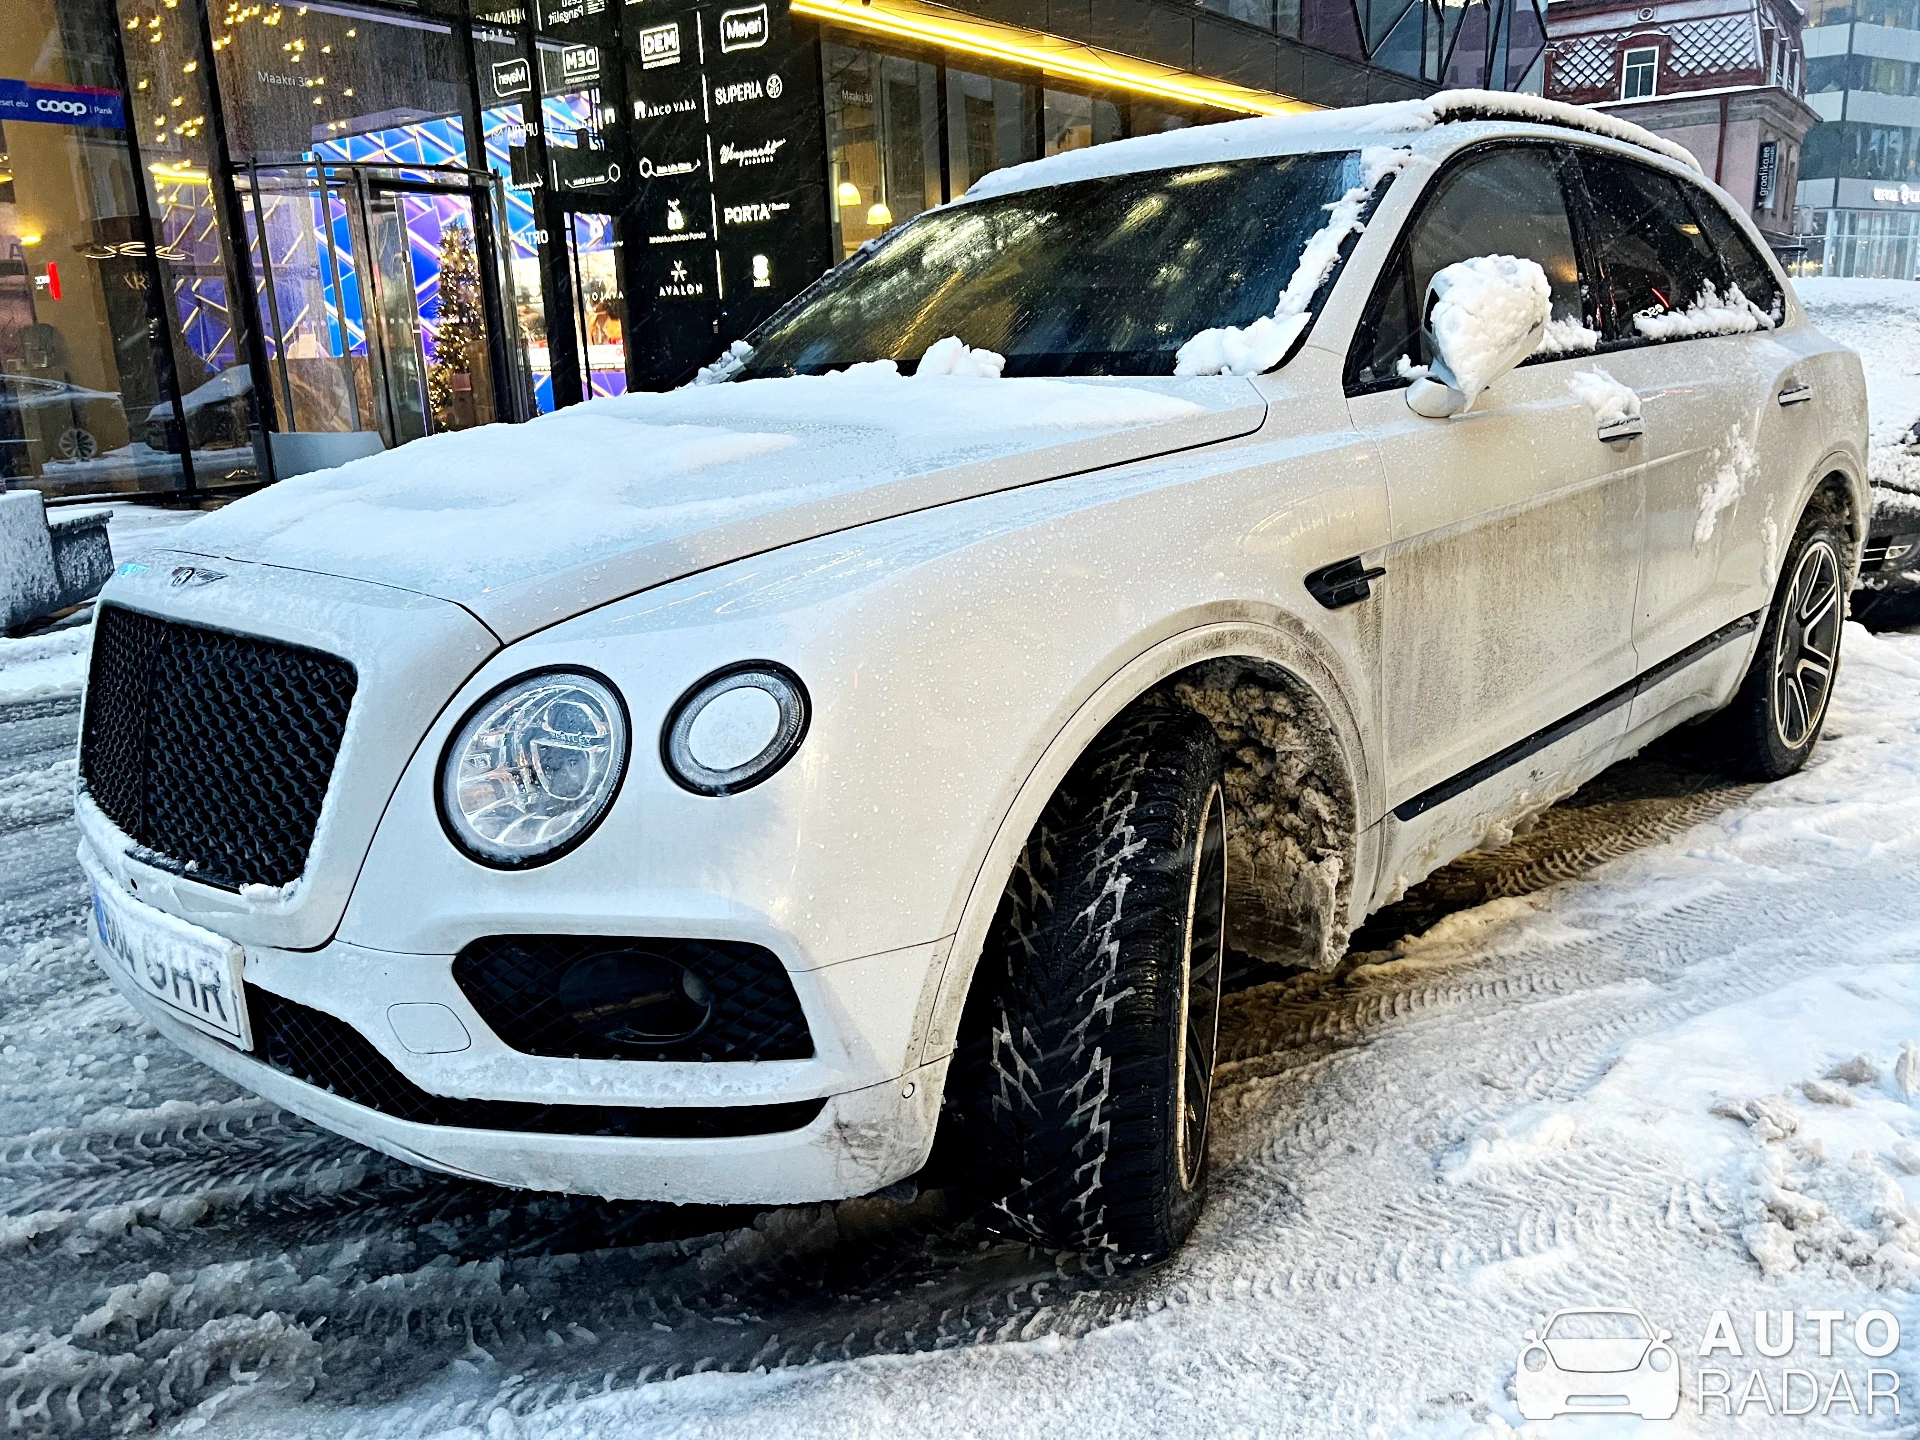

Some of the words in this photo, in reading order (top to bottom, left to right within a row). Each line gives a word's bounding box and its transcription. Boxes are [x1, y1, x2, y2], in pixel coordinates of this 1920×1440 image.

[643, 30, 678, 55] DEM
[257, 71, 296, 86] Maakri
[714, 79, 764, 106] SUPERIA
[841, 89, 864, 102] Maakri
[864, 93, 873, 104] 30
[36, 99, 87, 116] coop
[647, 103, 672, 118] ARCO
[672, 98, 697, 113] VARA
[723, 203, 771, 225] PORTA
[659, 283, 703, 297] AVALON
